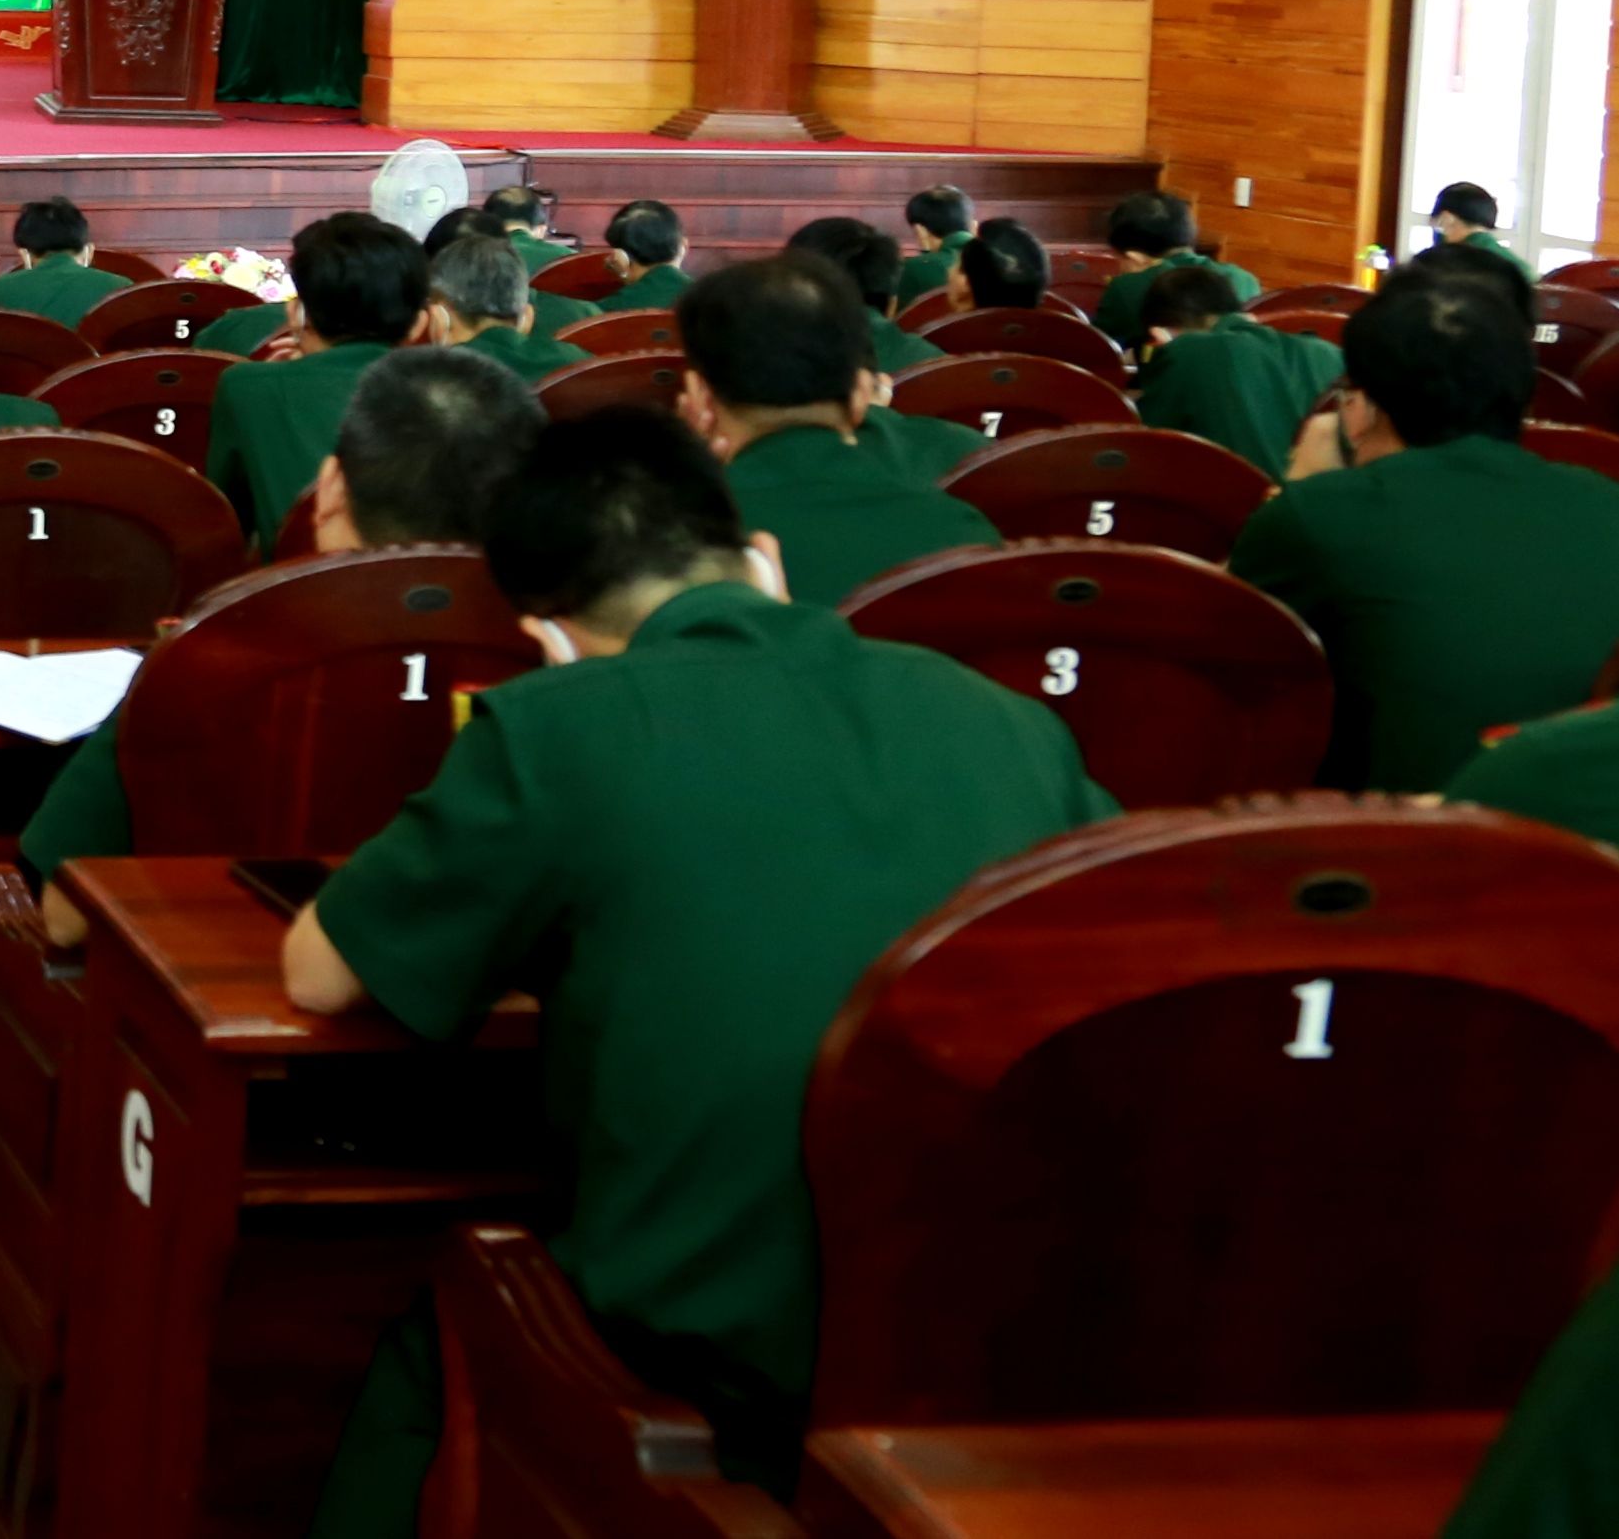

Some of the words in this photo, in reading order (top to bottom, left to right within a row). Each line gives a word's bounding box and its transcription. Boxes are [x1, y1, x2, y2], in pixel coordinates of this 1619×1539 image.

[175, 320, 189, 338] 5
[1533, 324, 1559, 343] 15
[155, 409, 176, 435] 3
[981, 412, 1002, 437] 7
[29, 508, 48, 539] 1
[1087, 501, 1114, 535] 5
[401, 654, 428, 700] 1
[1042, 648, 1079, 695] 3
[1287, 981, 1332, 1058] 1
[122, 1090, 153, 1205] G
